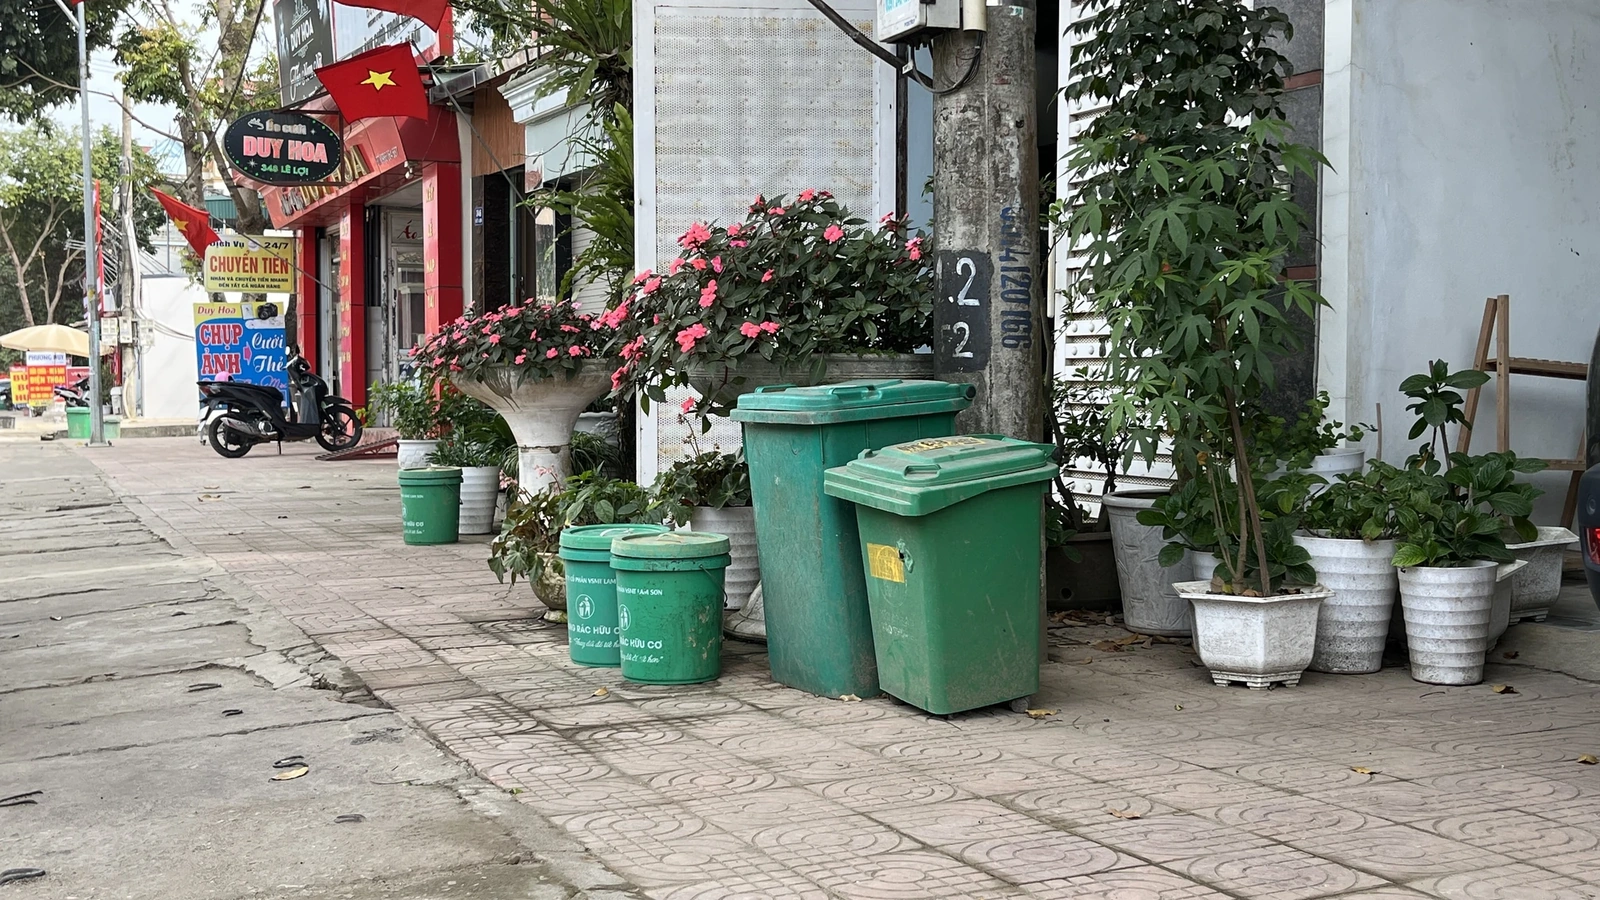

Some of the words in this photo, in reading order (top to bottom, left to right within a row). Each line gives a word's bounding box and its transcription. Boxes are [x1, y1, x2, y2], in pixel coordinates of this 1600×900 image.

[243, 136, 284, 158] DUY
[288, 140, 328, 164] HOA
[260, 164, 278, 172] 348
[281, 164, 291, 174] LÊ
[293, 166, 308, 176] LỢI
[233, 241, 244, 249] Vụ
[210, 250, 258, 274] CHUYỂN
[198, 306, 215, 316] Duy
[218, 306, 236, 314] Hoa
[200, 323, 243, 350] CHỤP
[252, 332, 284, 350] Cưới
[201, 348, 242, 376] ẢNH
[577, 624, 591, 633] RÁC
[593, 625, 610, 634] HỮU
[647, 640, 663, 649] CƠ
